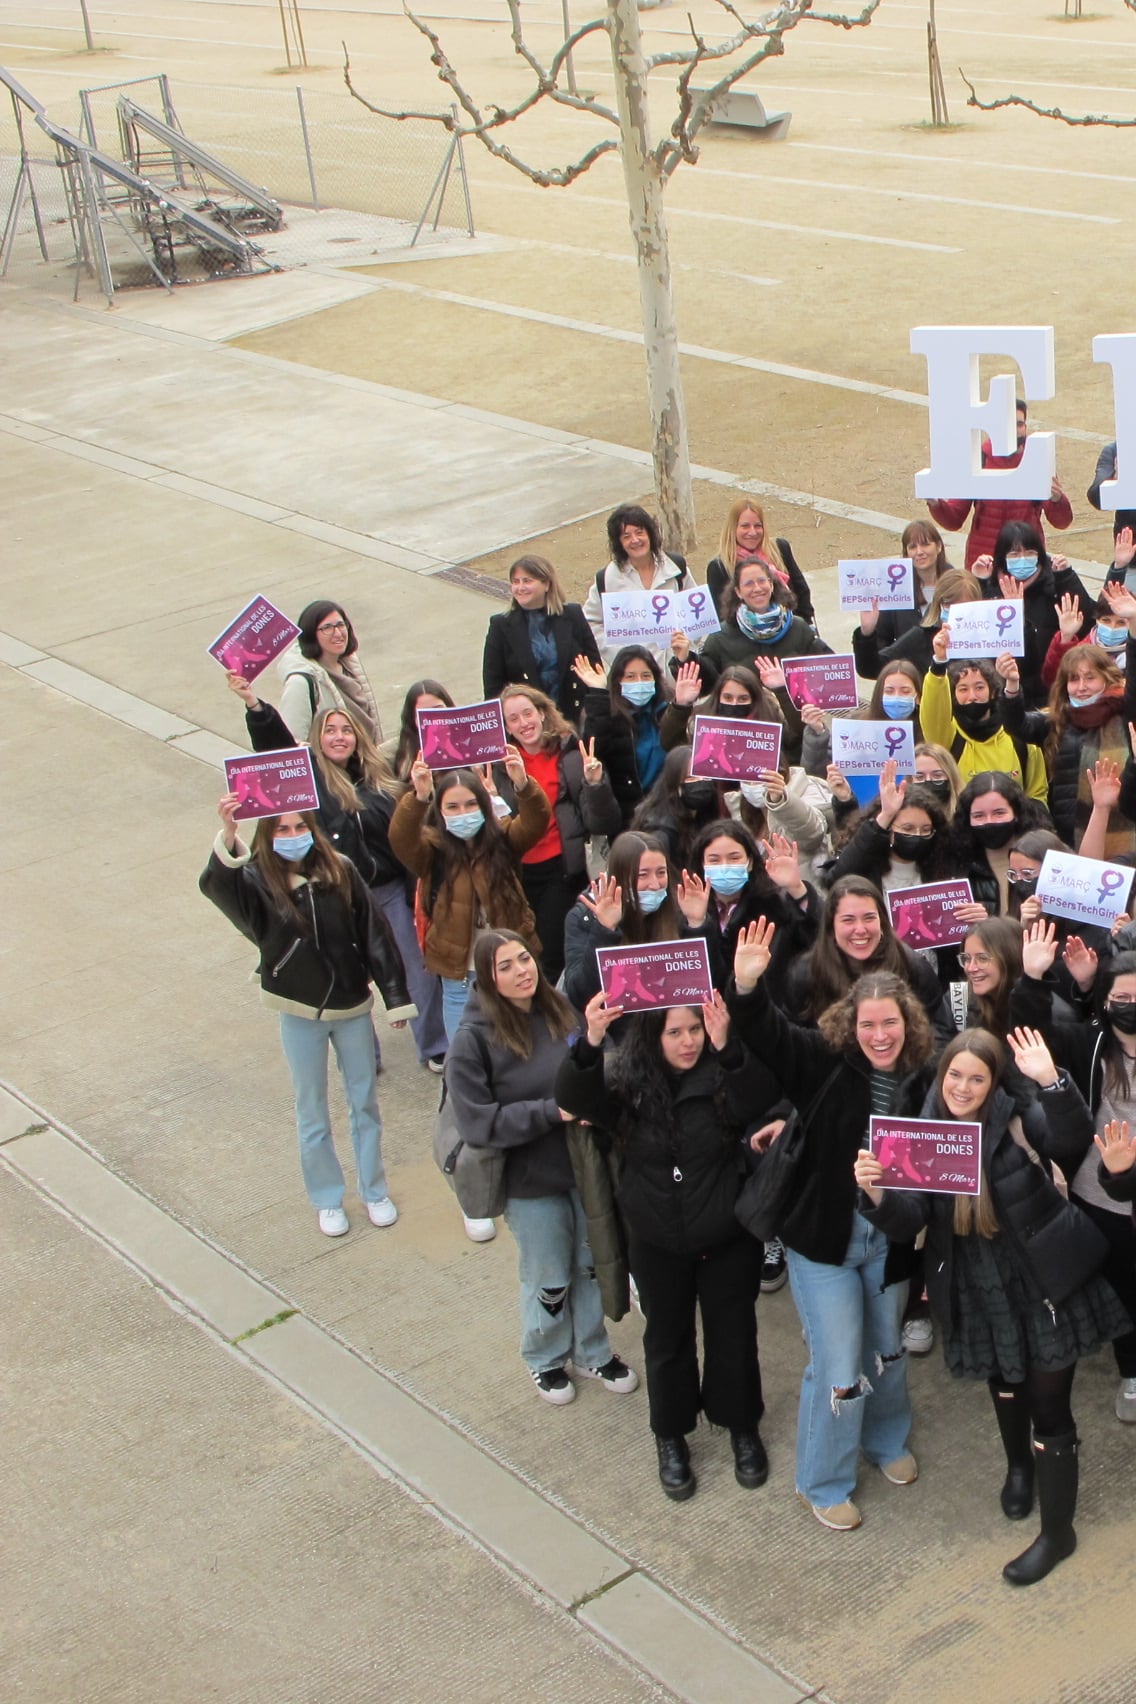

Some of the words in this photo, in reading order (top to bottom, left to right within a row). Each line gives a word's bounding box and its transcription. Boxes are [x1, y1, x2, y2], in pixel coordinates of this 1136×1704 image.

[251, 610, 275, 634] DONES
[824, 672, 851, 680] DONES
[470, 719, 499, 732] DONES
[746, 740, 775, 751] DONES
[835, 760, 912, 768] #EPSersTecGirls
[280, 767, 308, 780] DONES
[618, 954, 673, 966] INTERNATIONAL
[686, 950, 700, 958] LES
[665, 960, 702, 972] DONES
[890, 1130, 946, 1141] INTERNATIONAL
[947, 1134, 957, 1142] DE
[936, 1144, 974, 1156] DONES
